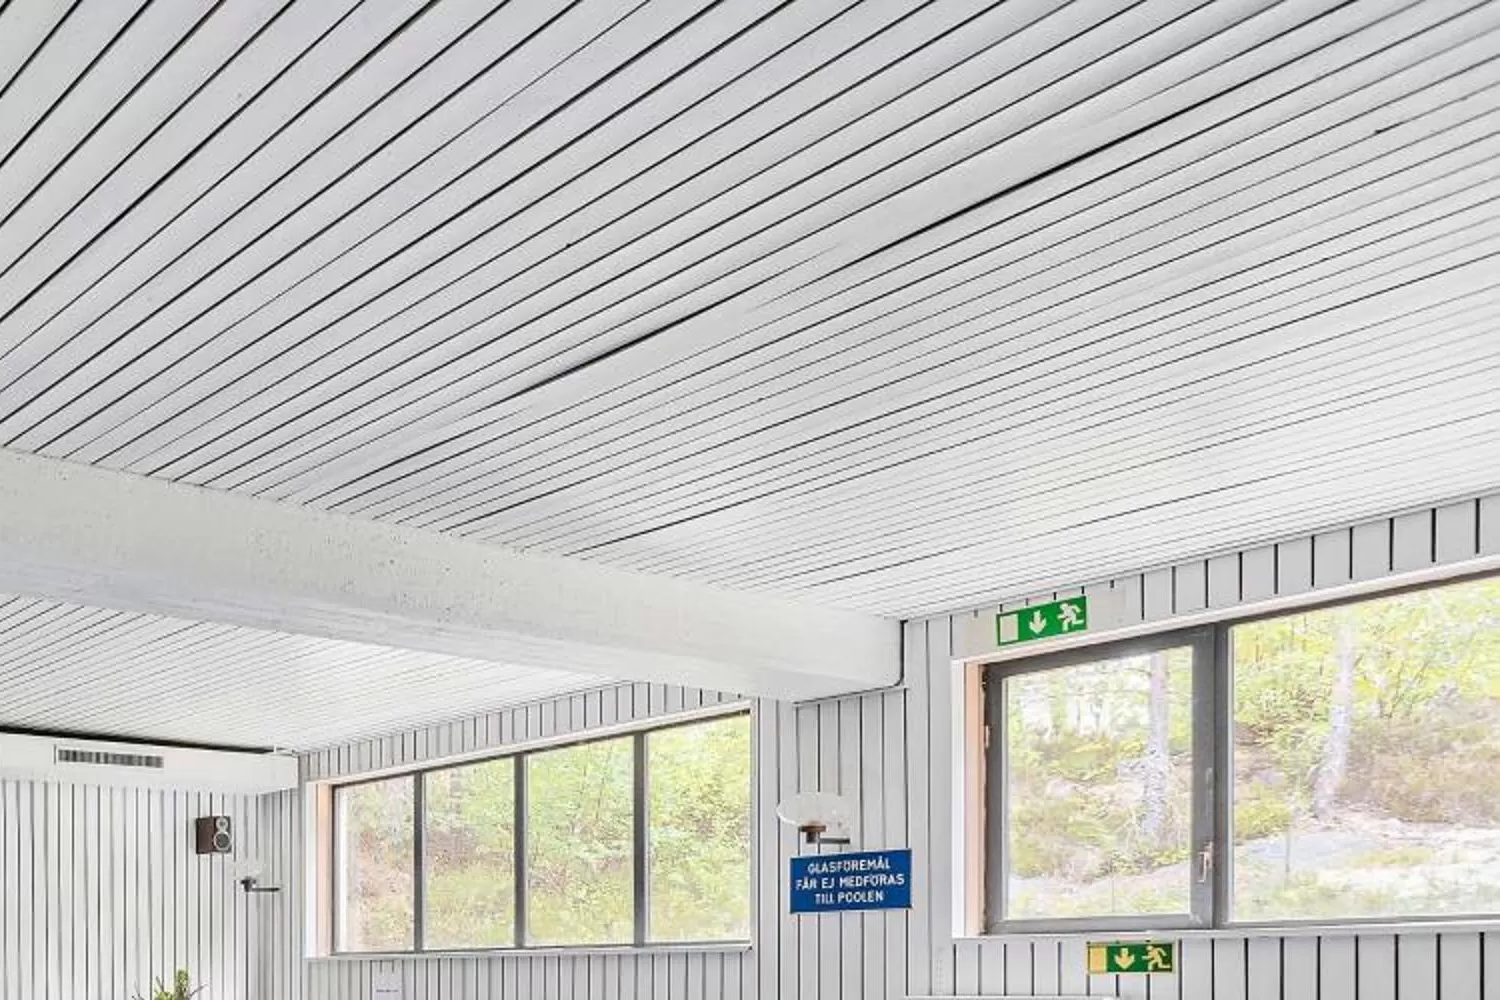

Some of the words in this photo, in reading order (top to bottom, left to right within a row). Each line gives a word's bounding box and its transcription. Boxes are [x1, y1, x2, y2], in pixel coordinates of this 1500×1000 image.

[795, 876, 817, 891] FÅR
[821, 877, 835, 889] EJ
[814, 893, 834, 905] TILL
[837, 889, 884, 904] POOLEN
